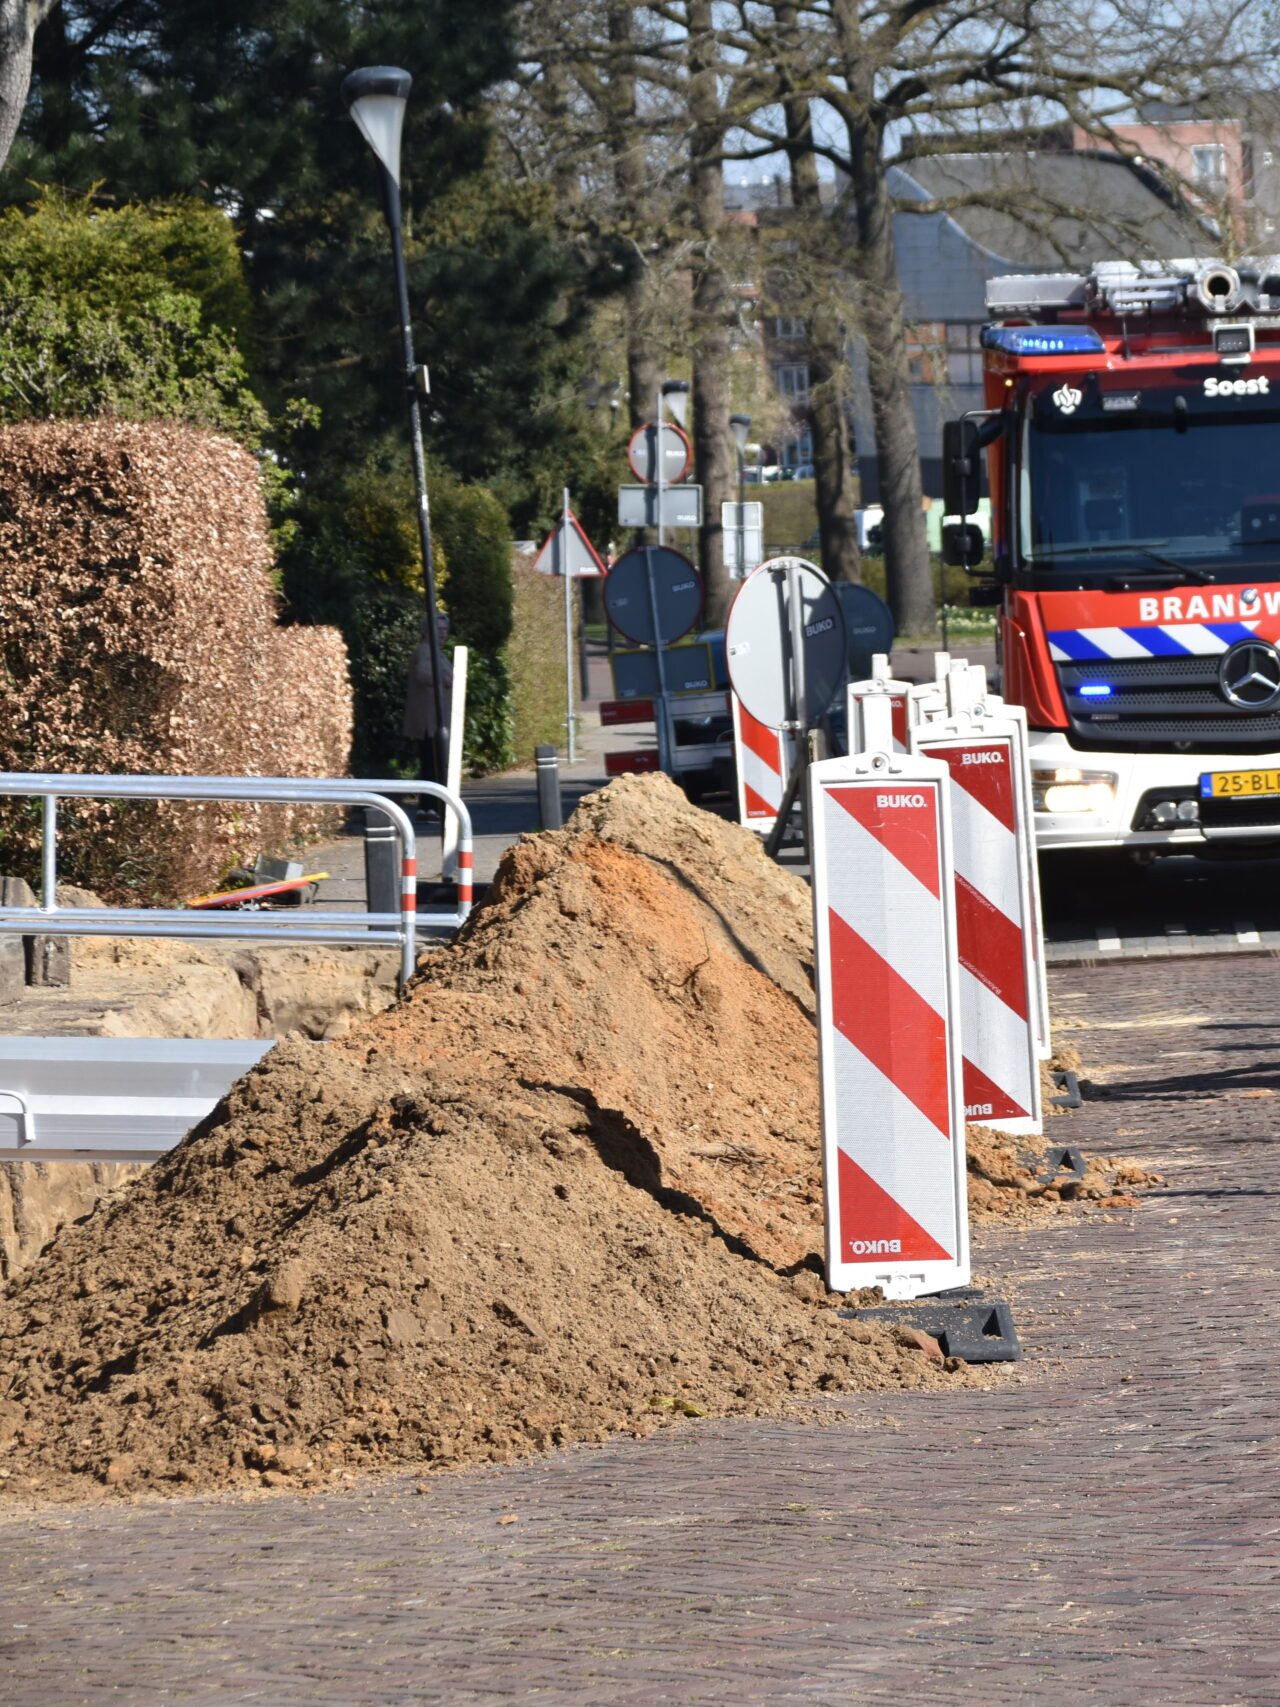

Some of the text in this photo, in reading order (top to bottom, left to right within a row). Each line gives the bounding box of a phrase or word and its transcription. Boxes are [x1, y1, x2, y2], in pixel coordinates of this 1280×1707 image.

[1203, 375, 1270, 398] Soest
[805, 618, 834, 638] BUKO
[961, 751, 1004, 766] BUKO.
[876, 794, 928, 808] BUKO.
[963, 1103, 994, 1117] BUK
[848, 1239, 902, 1255] BUKO.
